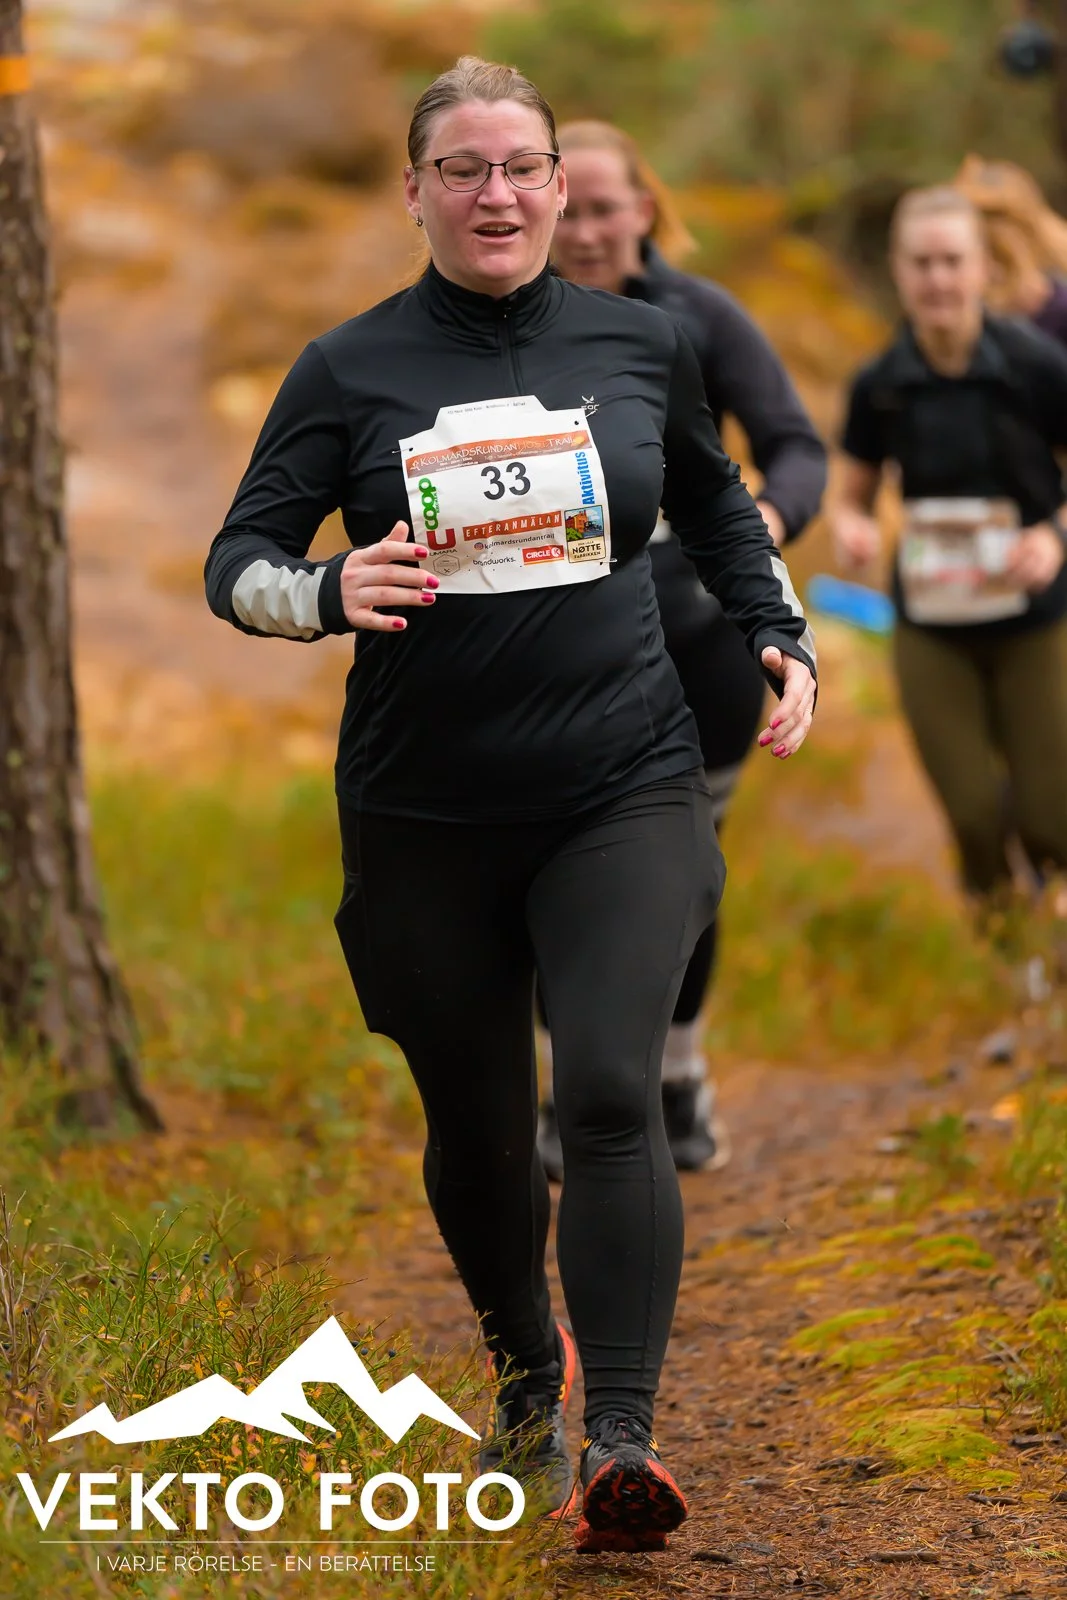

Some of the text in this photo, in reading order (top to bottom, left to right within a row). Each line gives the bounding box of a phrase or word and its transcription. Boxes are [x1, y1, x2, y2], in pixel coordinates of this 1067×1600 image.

[480, 461, 531, 500] 33
[575, 451, 596, 505] Aktivitus
[418, 478, 438, 530] coop
[465, 514, 560, 538] EFTERANMÄLAN
[525, 549, 551, 559] CIRCLE
[572, 543, 602, 554] NØTTE
